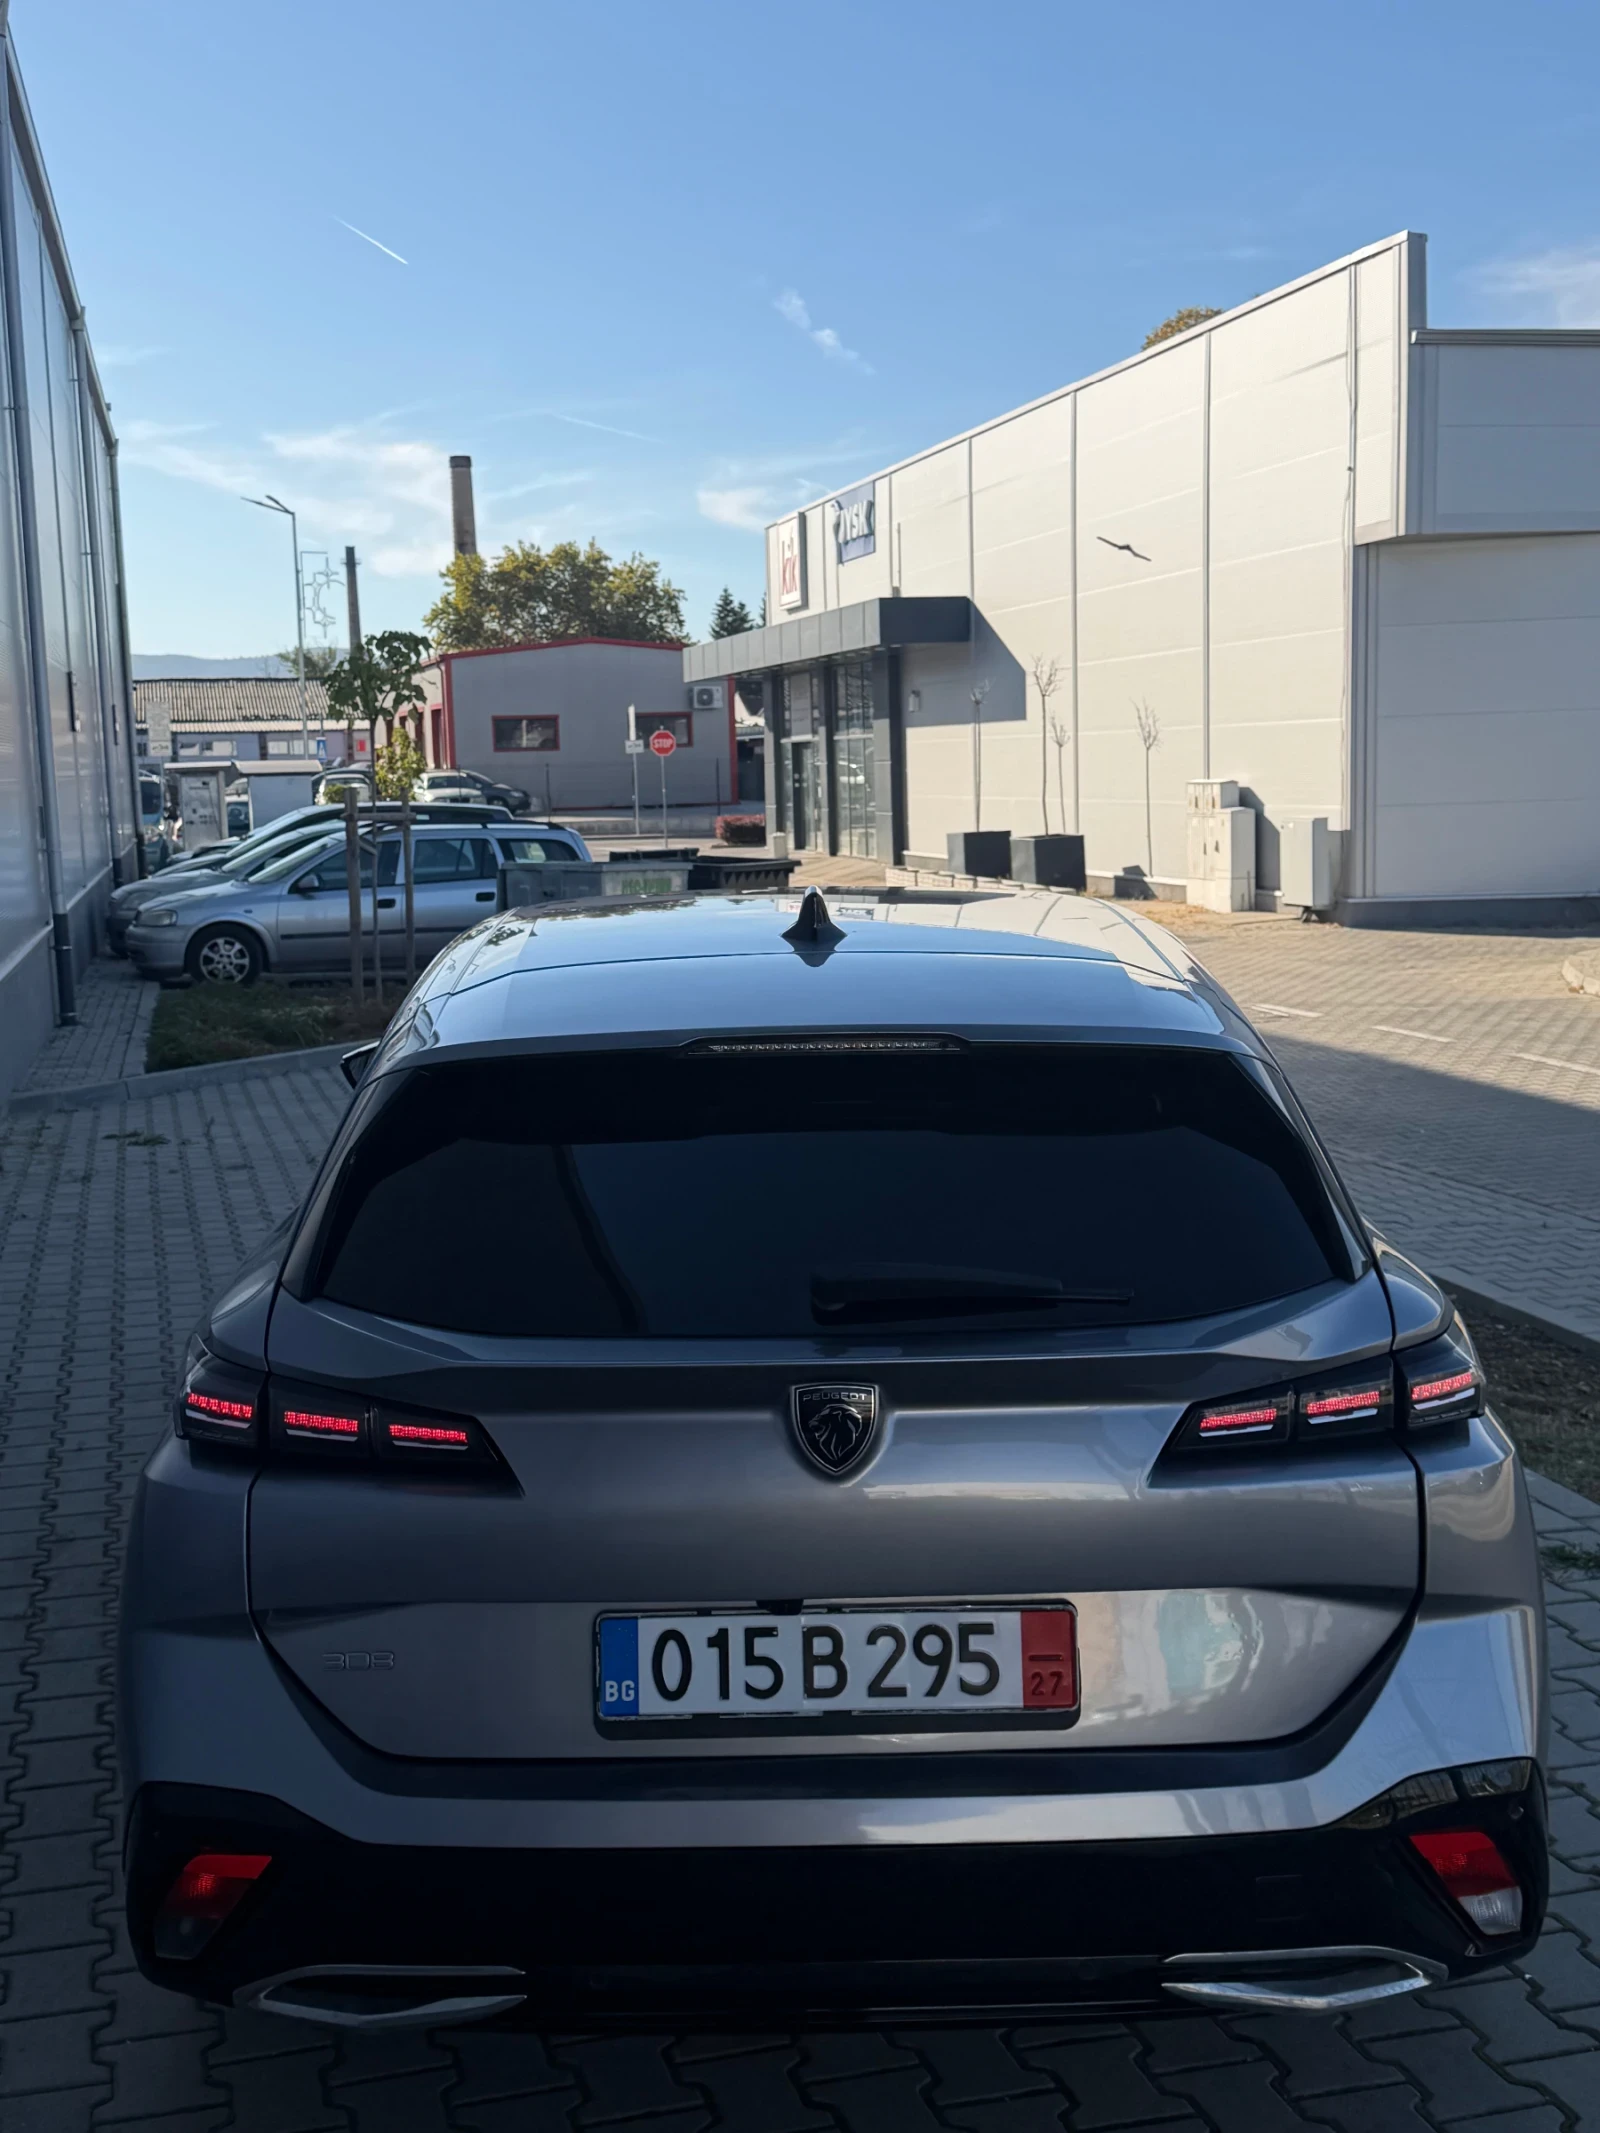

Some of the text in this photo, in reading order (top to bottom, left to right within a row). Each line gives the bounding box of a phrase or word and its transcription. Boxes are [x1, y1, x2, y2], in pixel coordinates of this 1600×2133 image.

[838, 500, 870, 544] JYSK
[653, 738, 674, 749] STOP
[803, 1392, 868, 1401] PEUGEOT
[322, 1652, 395, 1671] 308
[605, 1681, 636, 1702] BG
[1031, 1671, 1064, 1697] 27
